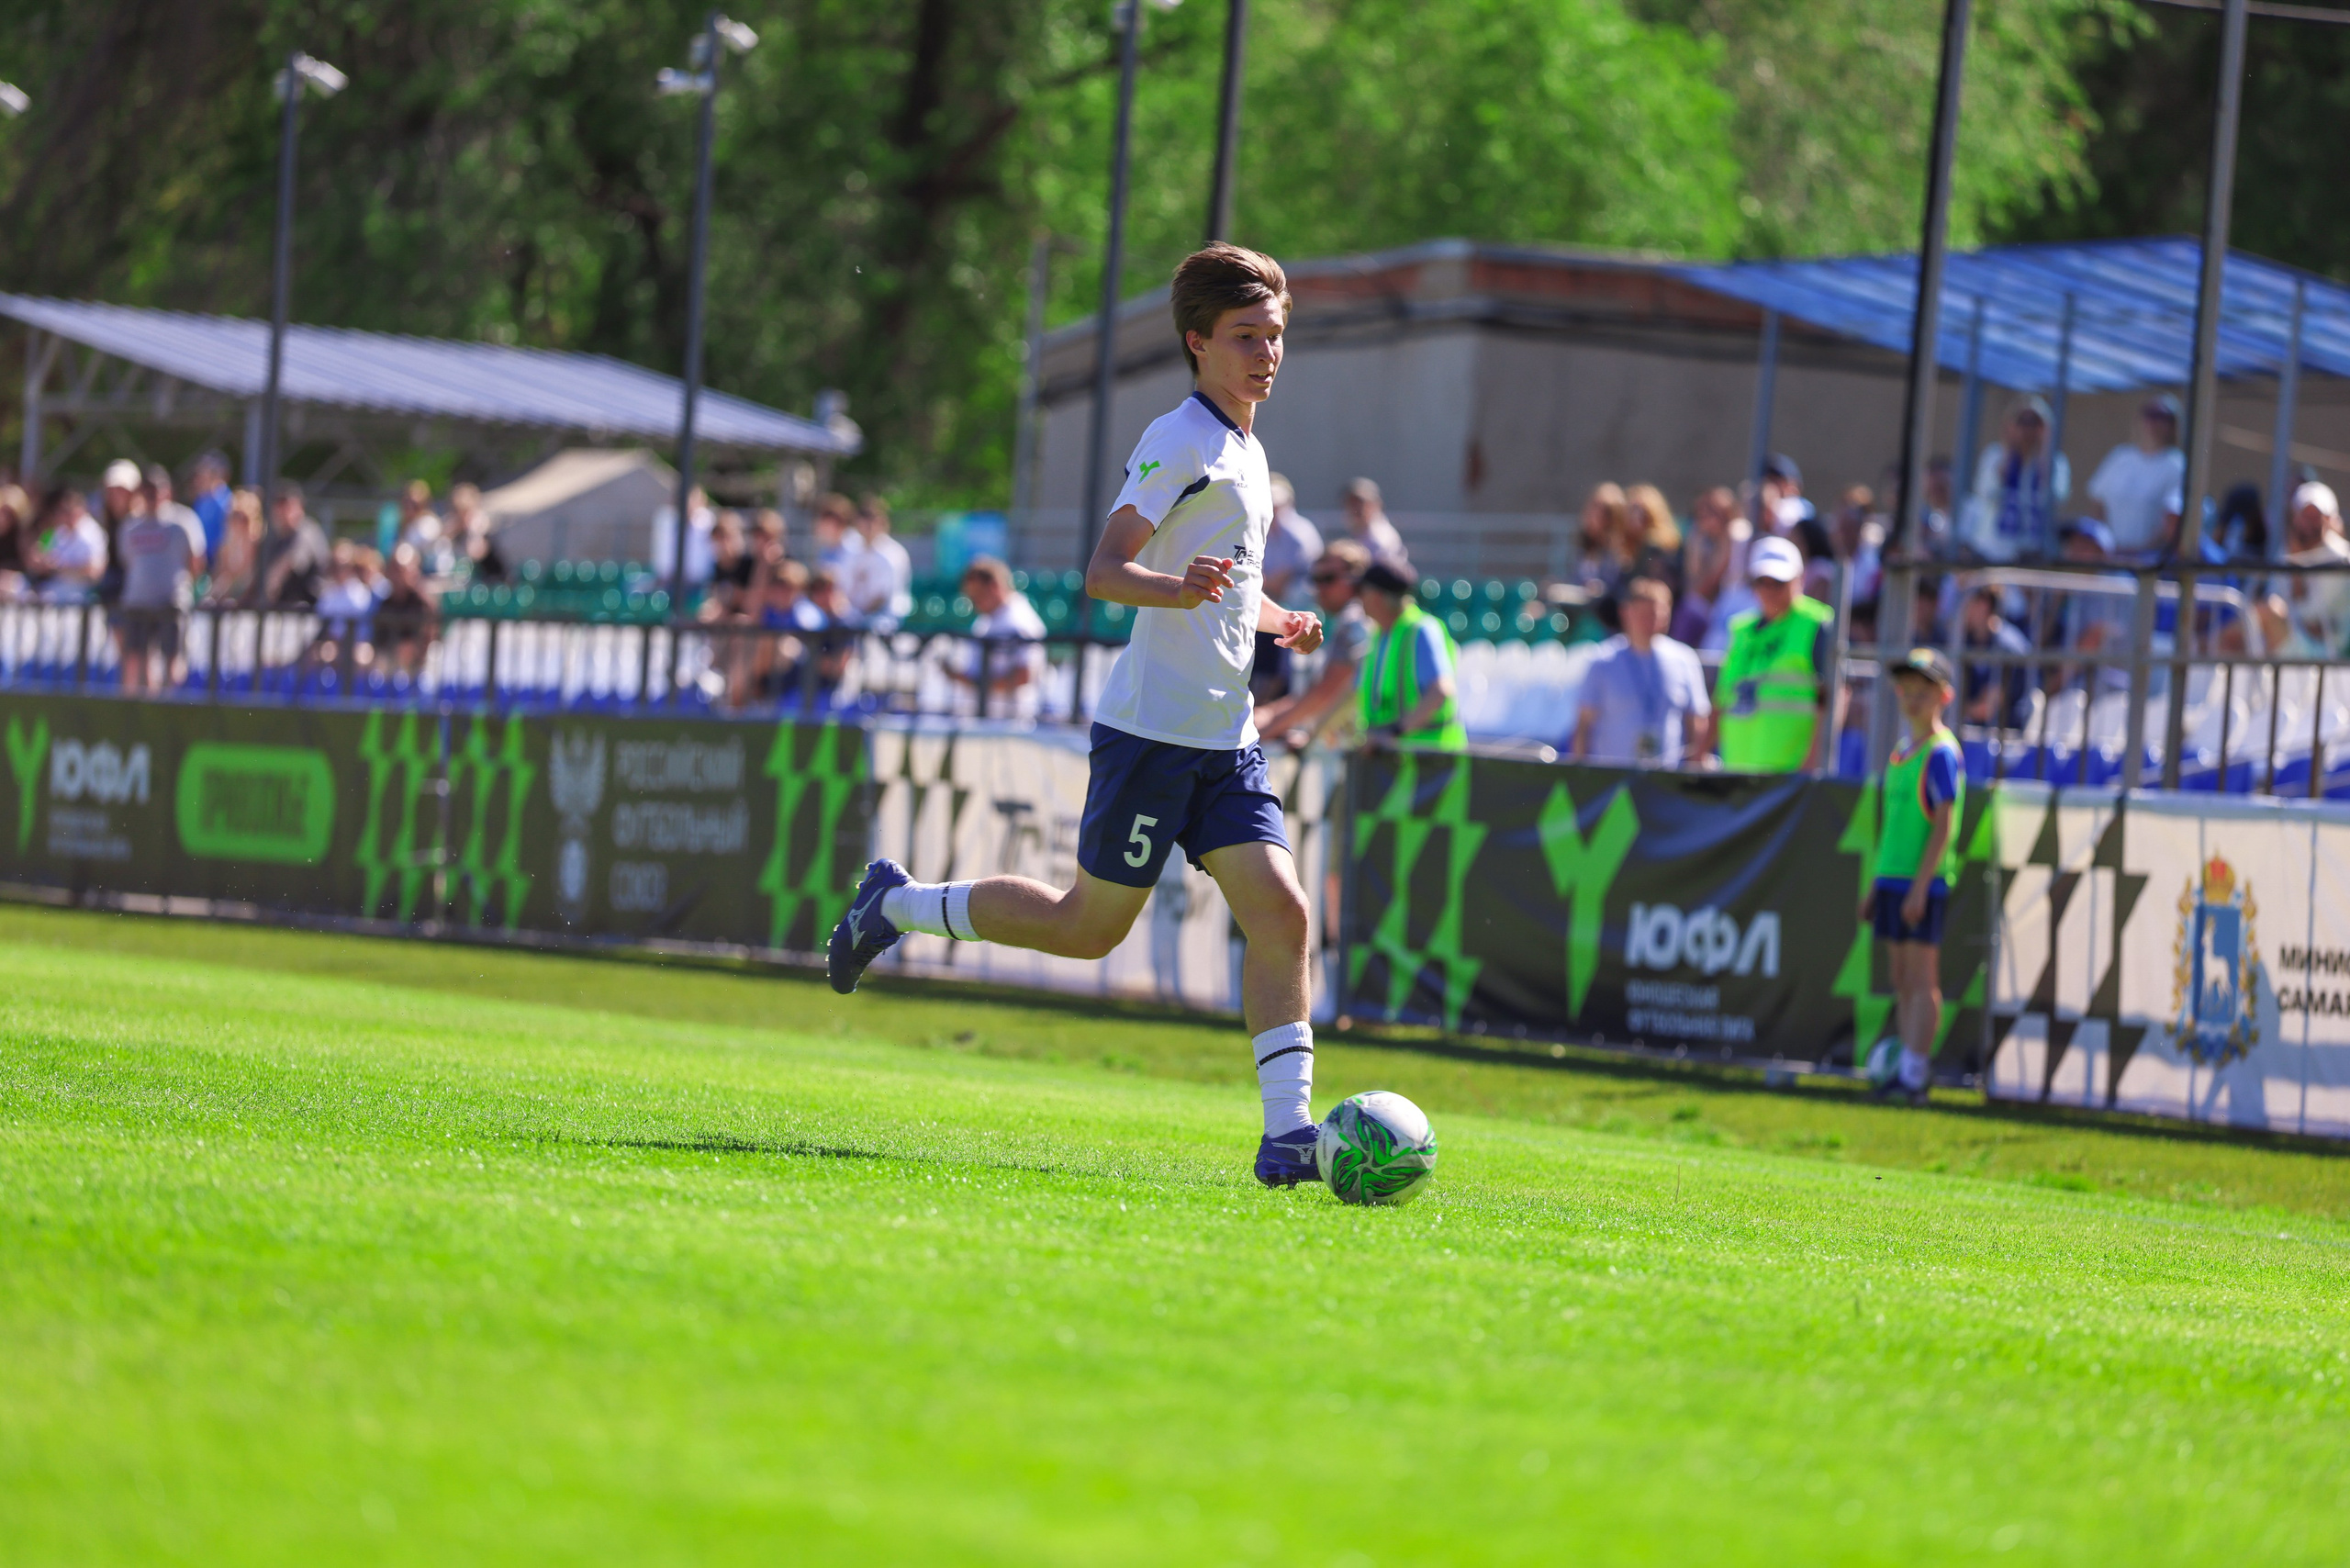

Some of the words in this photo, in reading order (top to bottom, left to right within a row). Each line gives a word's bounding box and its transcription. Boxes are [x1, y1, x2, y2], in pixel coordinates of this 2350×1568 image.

[51, 738, 151, 804] ЮФЛ
[1123, 813, 1158, 868] 5
[1625, 901, 1781, 979] ЮФЛ
